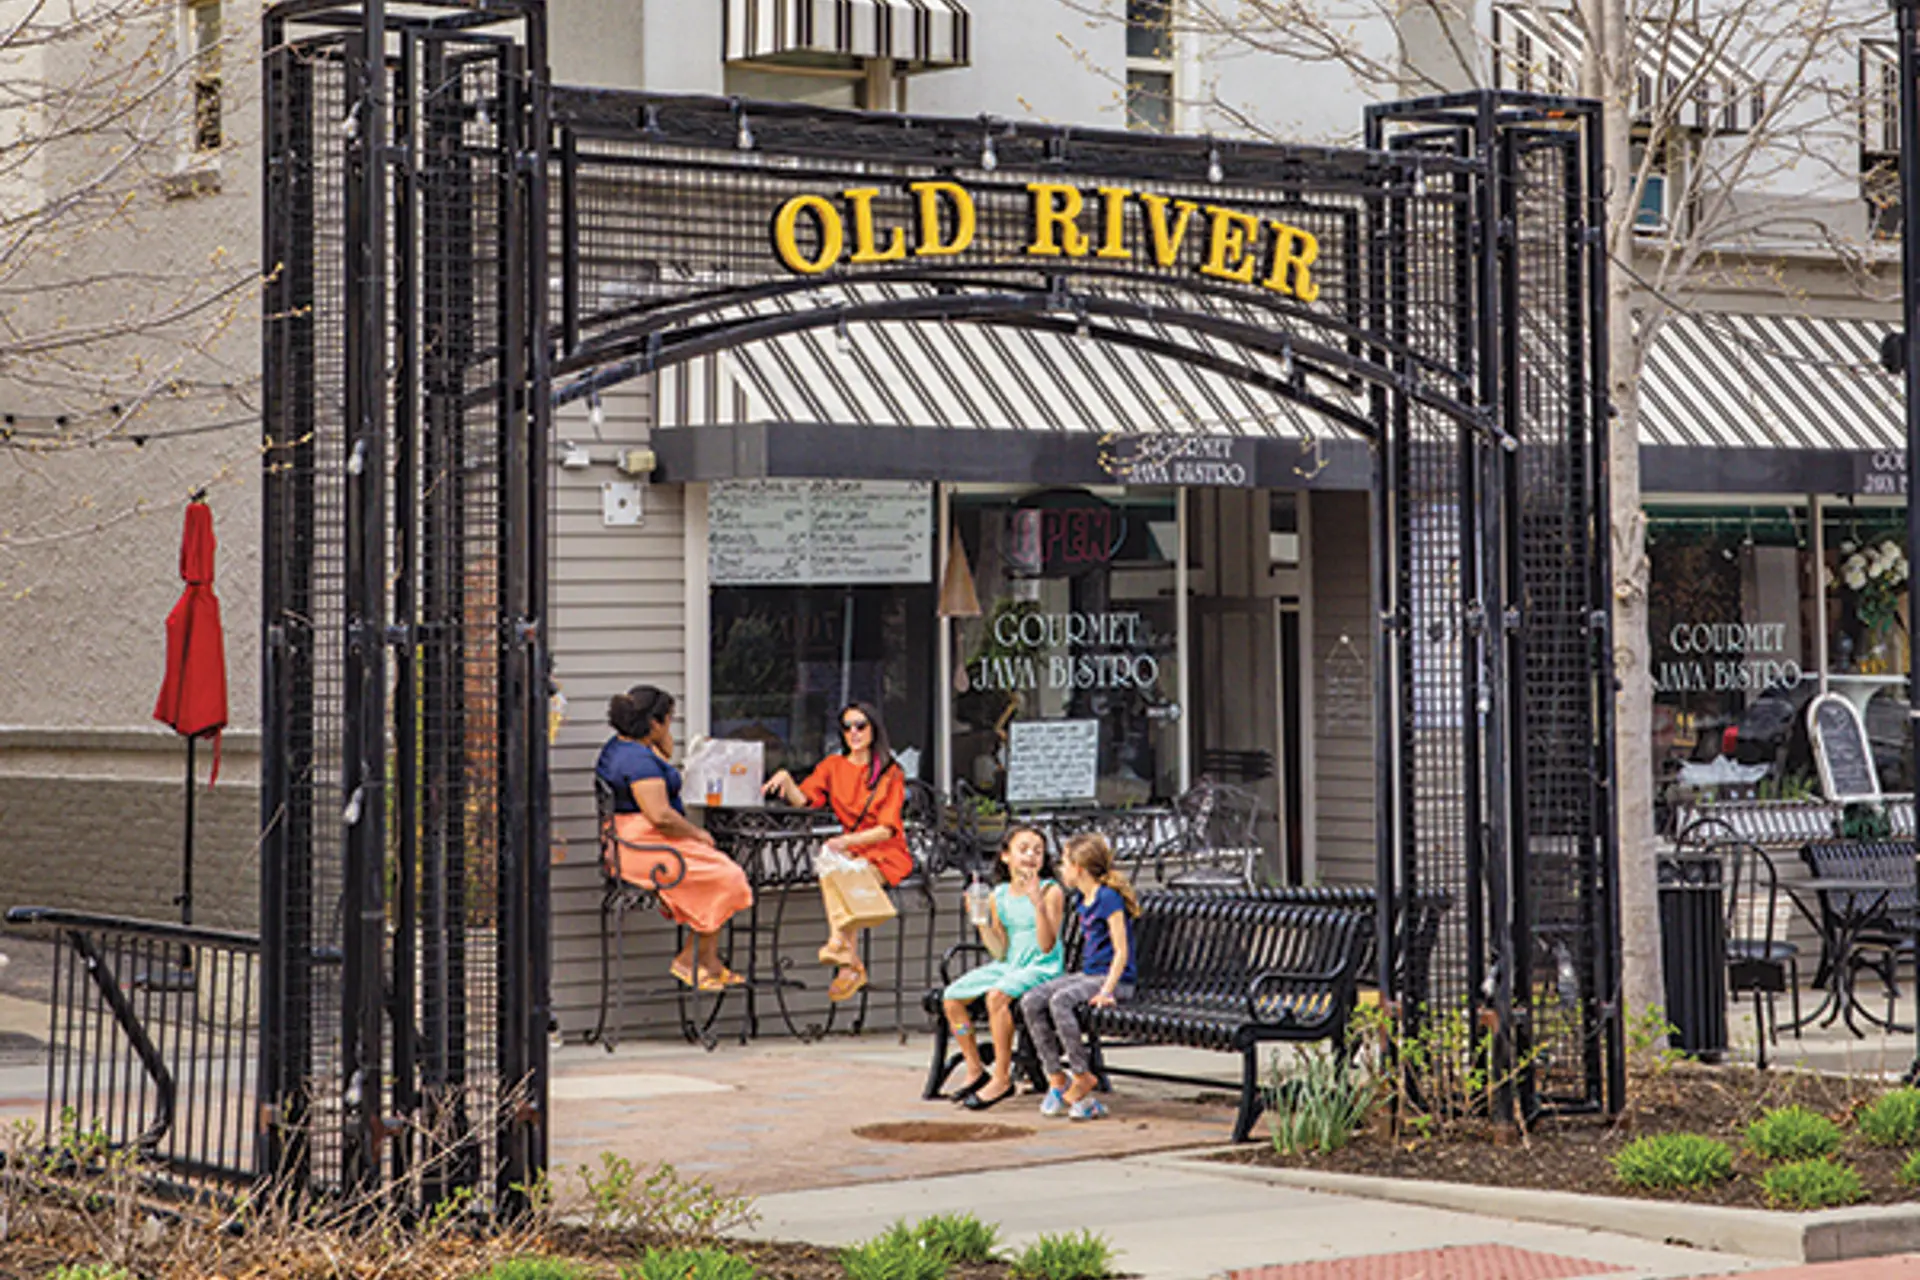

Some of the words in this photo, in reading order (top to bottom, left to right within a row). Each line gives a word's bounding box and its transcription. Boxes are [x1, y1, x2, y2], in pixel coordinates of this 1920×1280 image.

[772, 181, 976, 274] OLD
[1025, 183, 1320, 301] RIVER
[1174, 462, 1246, 485] BISTRO
[1011, 507, 1111, 562] OPEN
[994, 611, 1140, 647] GOURMET
[1669, 623, 1786, 654] GOURMET
[972, 655, 1038, 691] JAVA
[1049, 653, 1159, 689] BISTRO
[1656, 660, 1706, 691] JAVA
[1714, 659, 1801, 690] BISTRO
